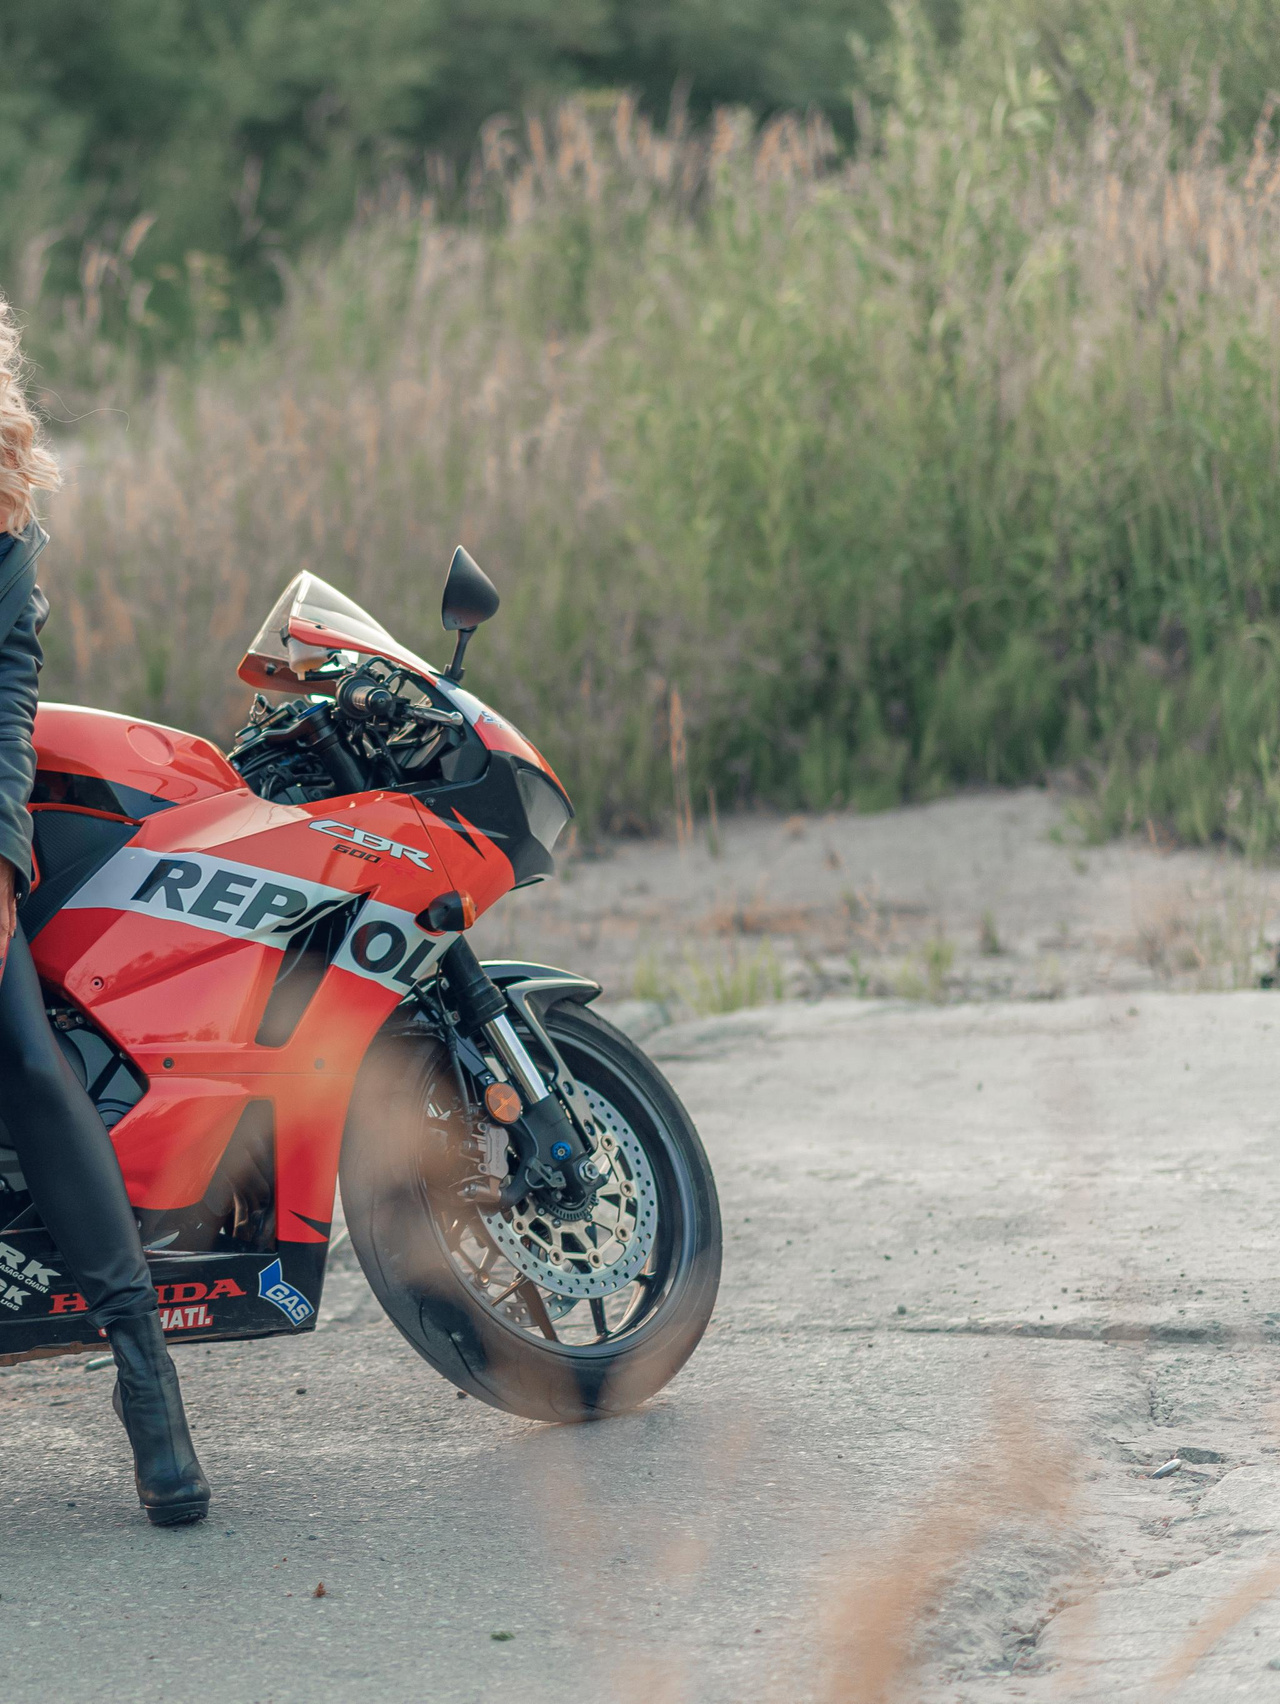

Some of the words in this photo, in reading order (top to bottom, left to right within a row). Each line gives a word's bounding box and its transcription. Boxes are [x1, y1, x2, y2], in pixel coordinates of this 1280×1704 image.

[308, 819, 434, 872] CBR
[130, 859, 437, 987] REPSOL
[24, 1278, 49, 1294] CHAIN
[265, 1283, 310, 1321] GAS
